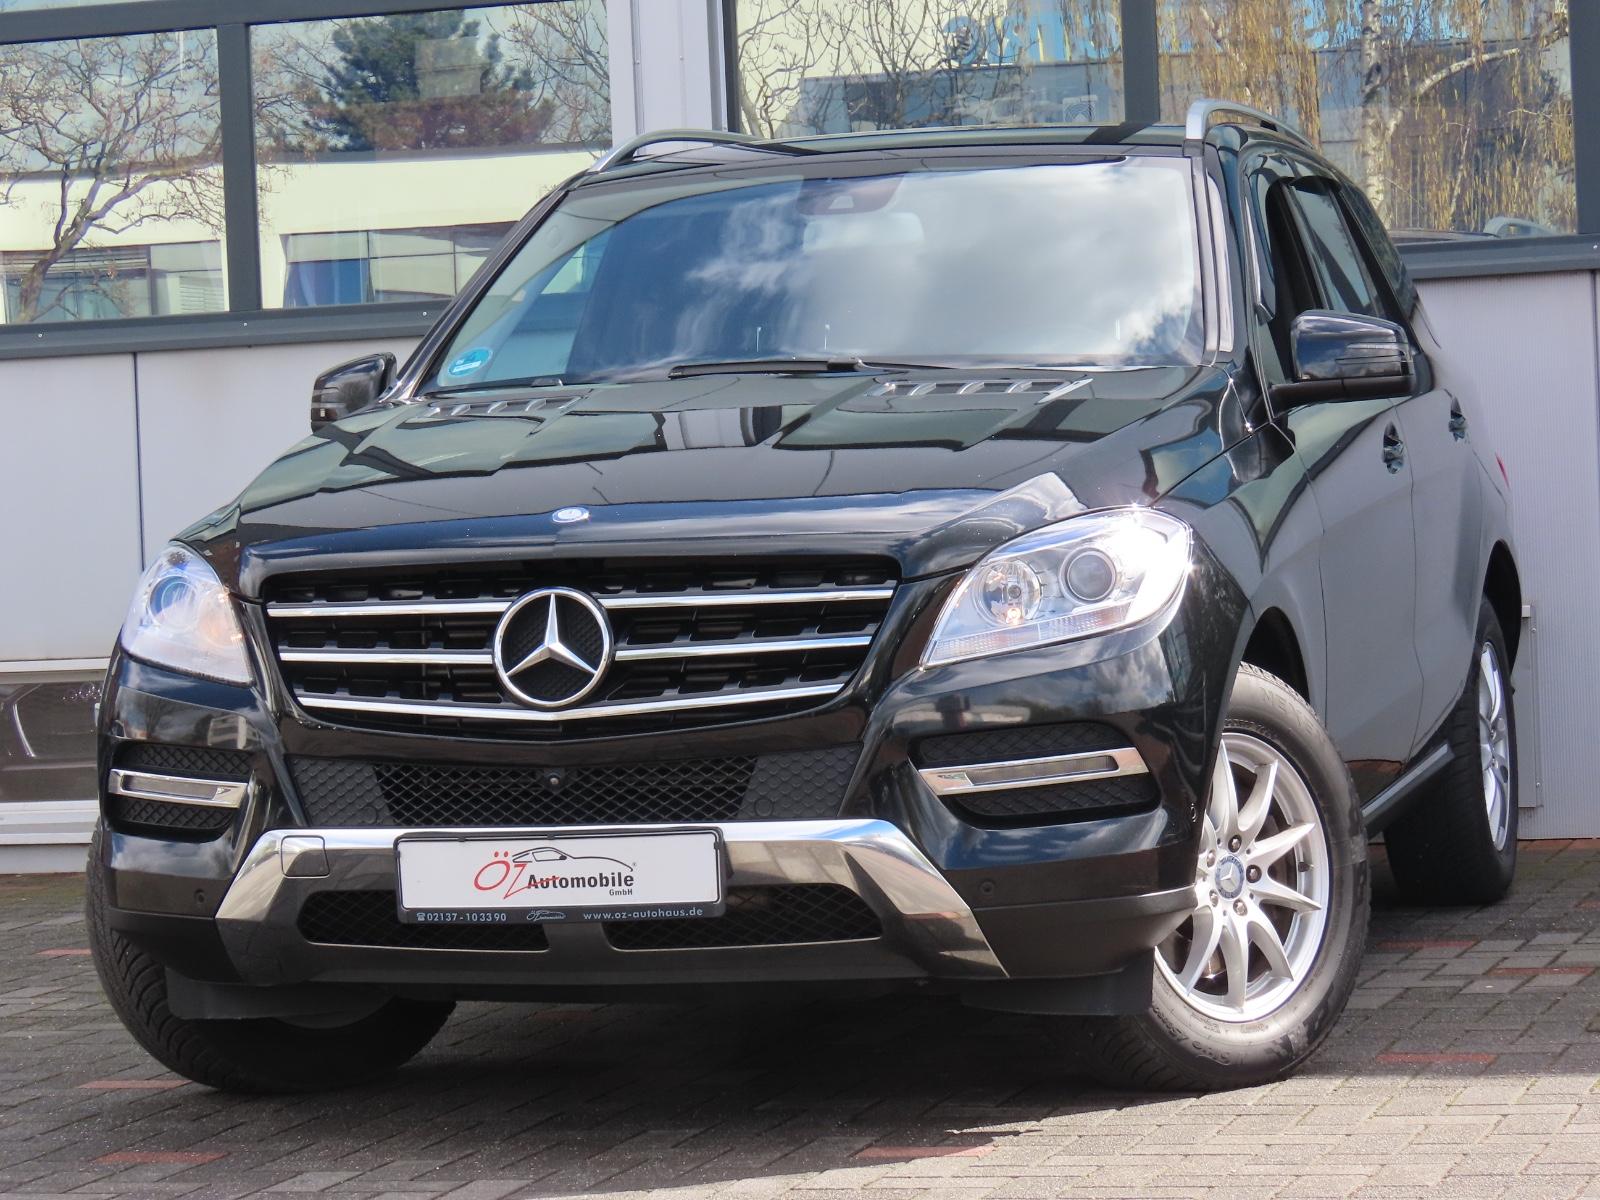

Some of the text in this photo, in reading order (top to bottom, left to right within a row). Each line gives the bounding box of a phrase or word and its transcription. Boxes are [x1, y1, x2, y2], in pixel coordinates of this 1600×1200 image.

[527, 871, 634, 889] Automobile
[608, 887, 633, 897] GmbH
[583, 906, 703, 920] www.oz-autohaus.de
